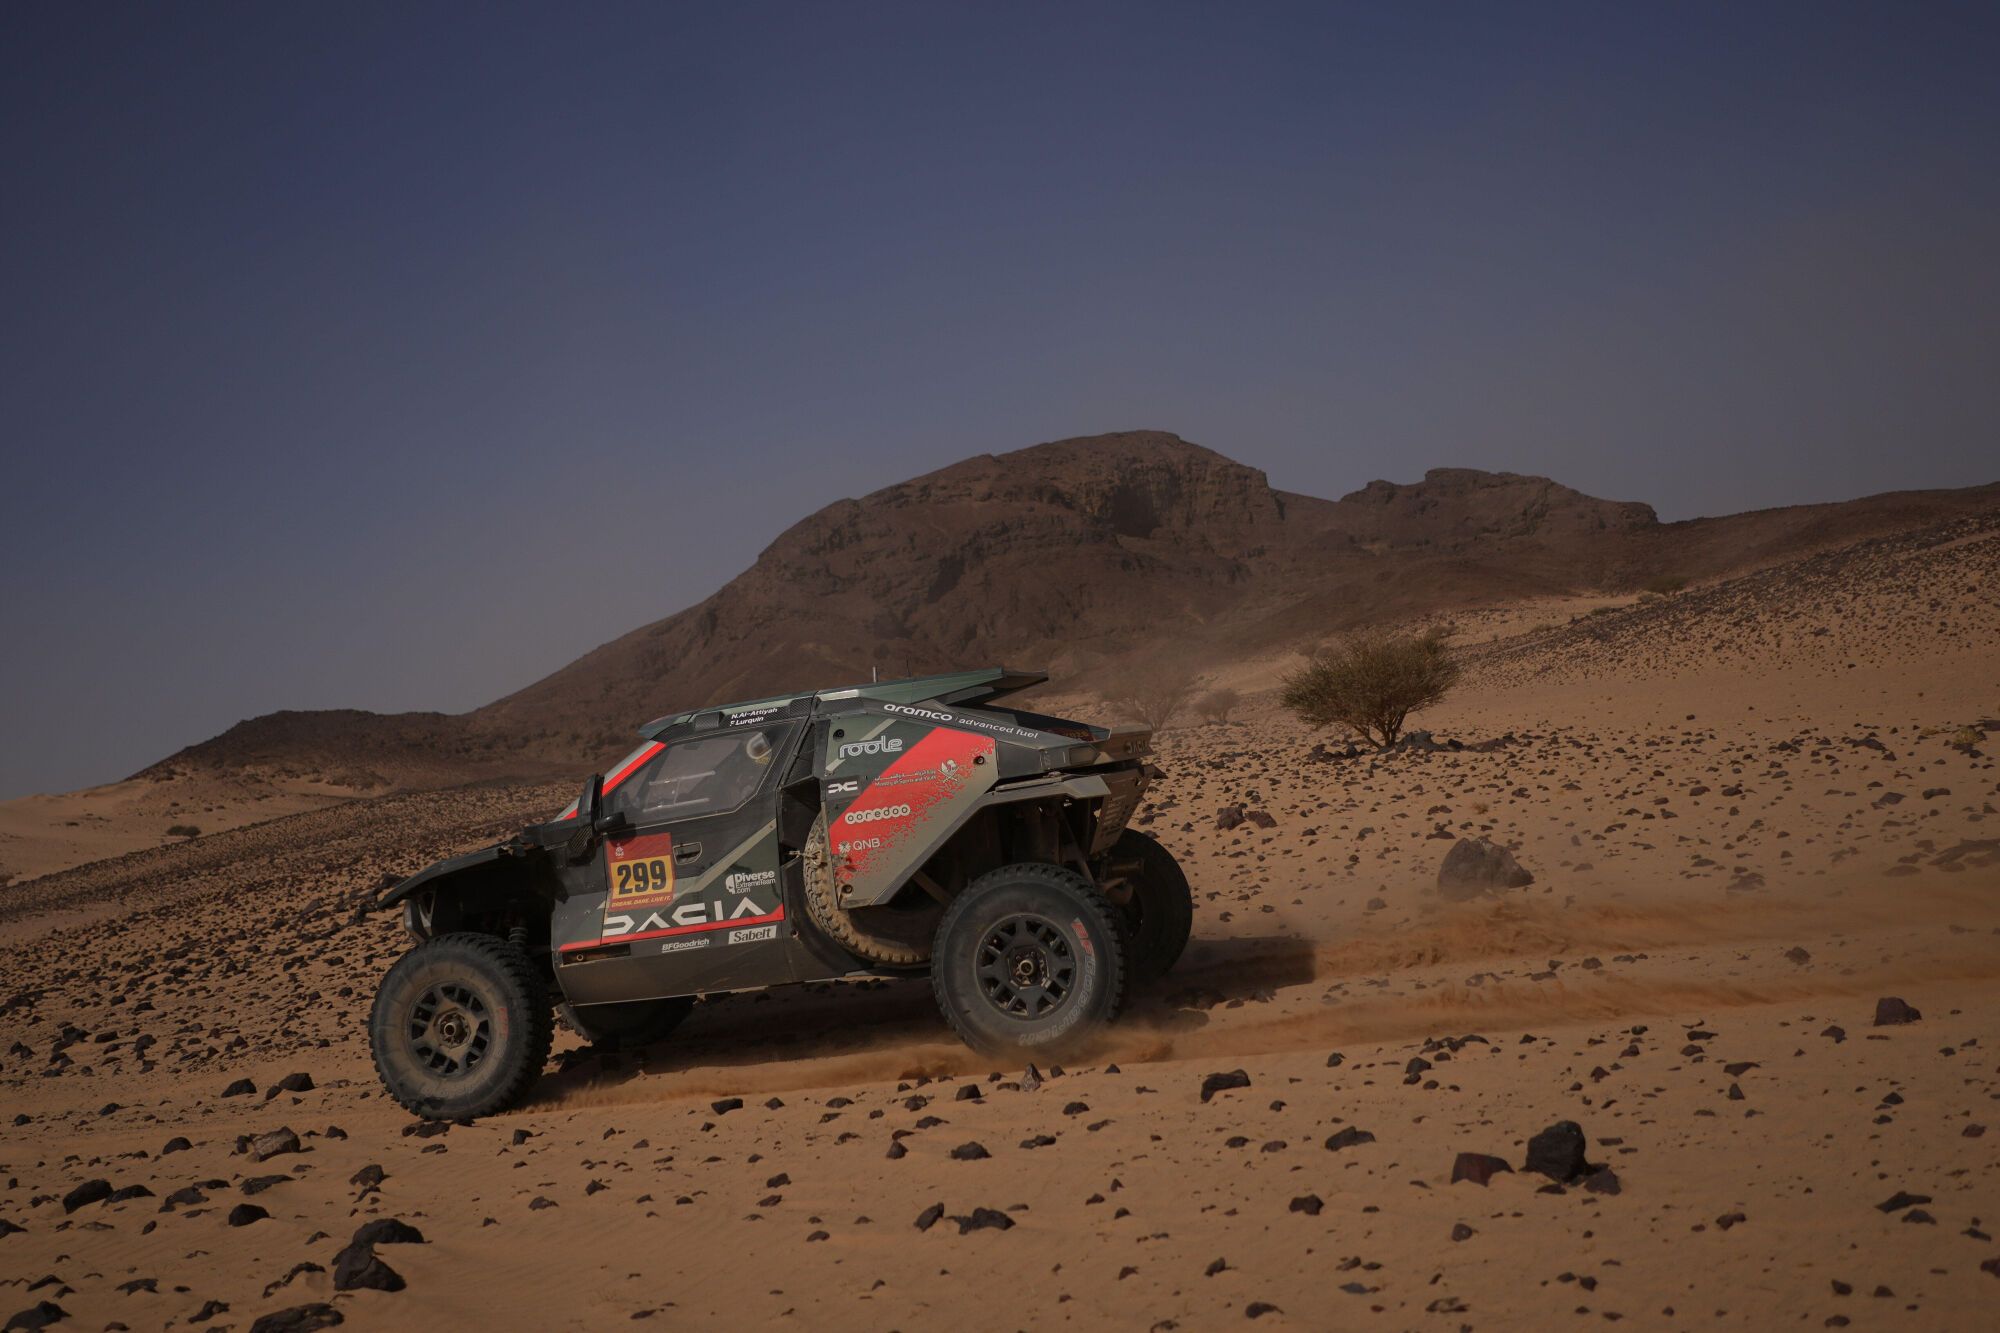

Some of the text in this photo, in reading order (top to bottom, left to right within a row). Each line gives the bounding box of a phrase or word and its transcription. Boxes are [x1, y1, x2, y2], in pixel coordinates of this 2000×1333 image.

[883, 703, 1039, 739] aramco advanced fuel
[839, 735, 903, 758] roole
[846, 805, 910, 823] ooredoo
[853, 838, 880, 850] QNB
[617, 860, 667, 895] 299
[734, 870, 775, 882] Diverse
[601, 896, 767, 937] DACIA
[733, 928, 772, 943] Sabelt
[662, 938, 710, 952] BFGoodrich
